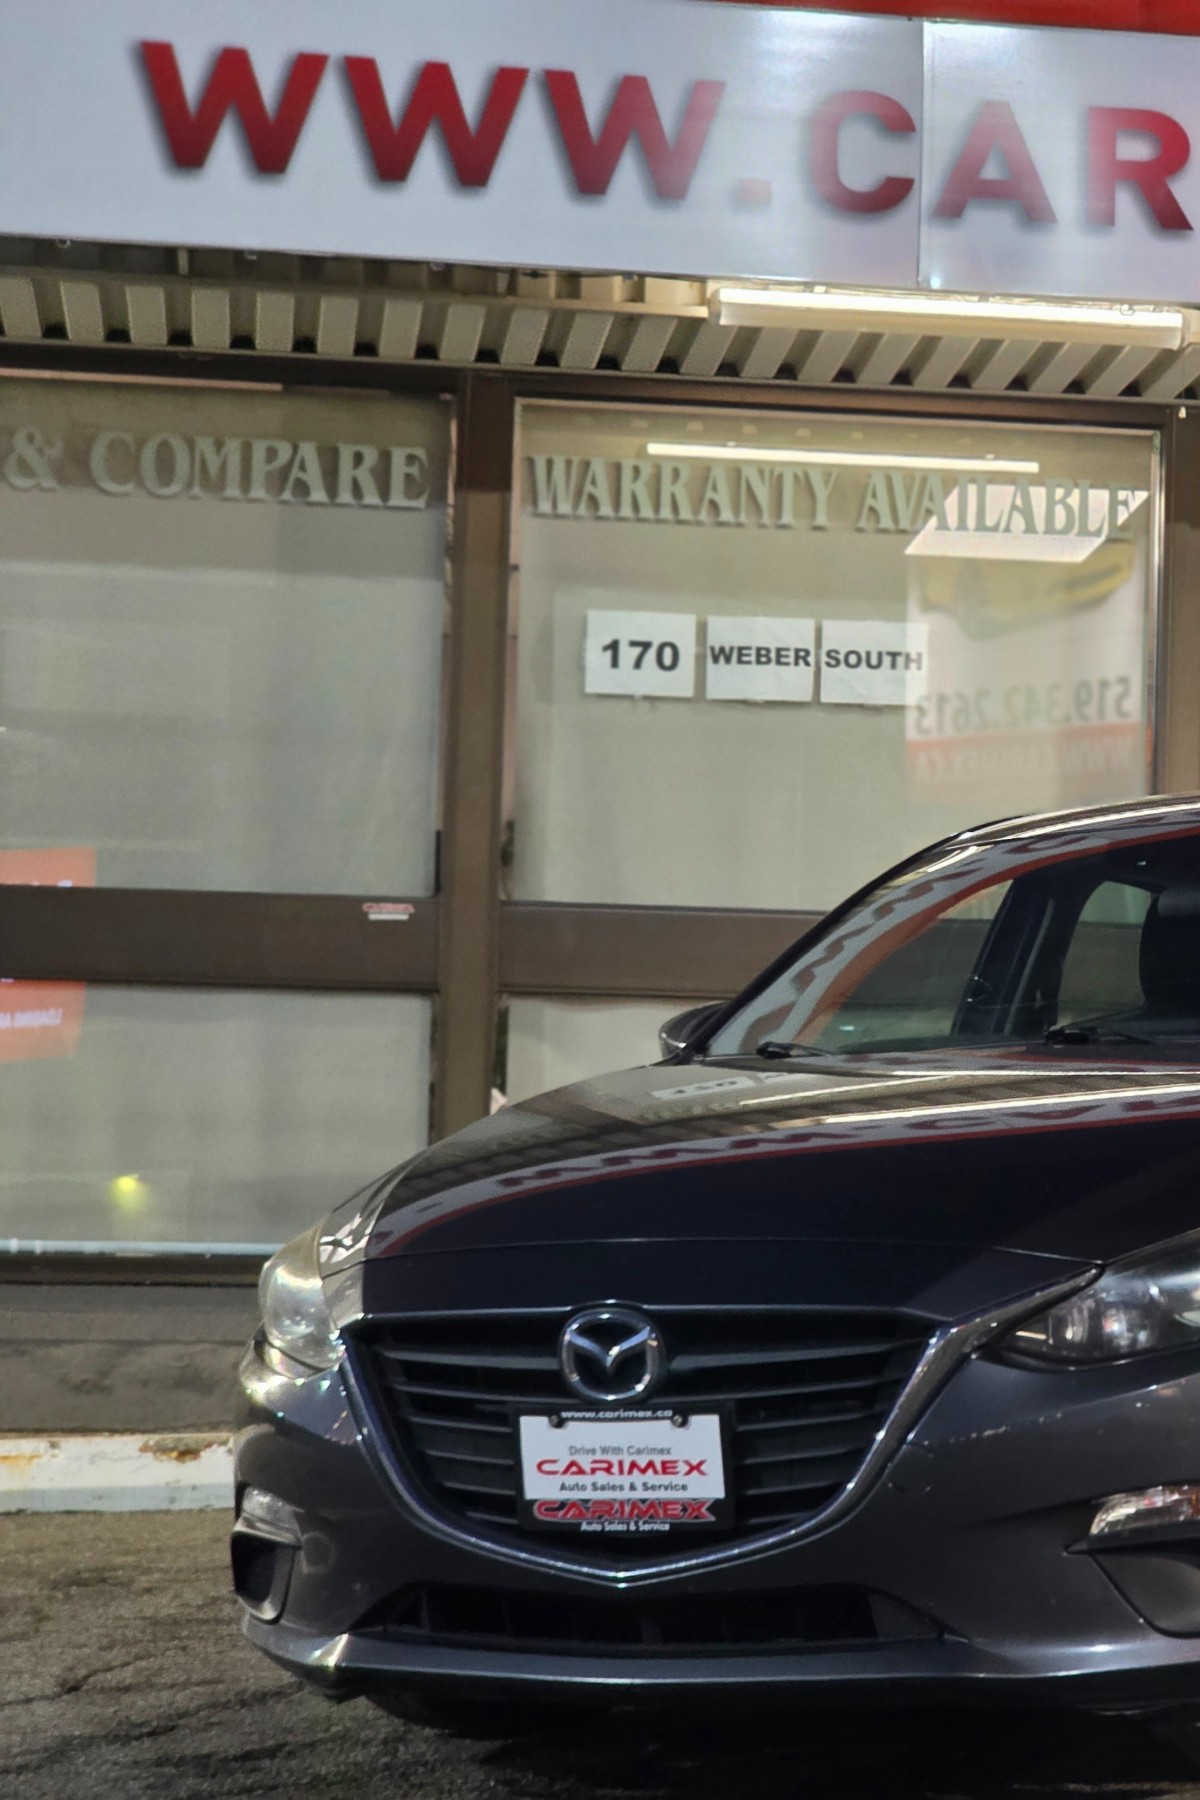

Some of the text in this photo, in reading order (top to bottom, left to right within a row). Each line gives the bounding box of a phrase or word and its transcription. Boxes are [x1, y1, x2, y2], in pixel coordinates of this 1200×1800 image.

[2, 426, 429, 510] & COMPARE
[530, 455, 1136, 540] WARRANTY AVAILABLE
[600, 639, 923, 672] 170 WEBER SOUTH
[560, 1408, 673, 1419] www.carimex.ca
[568, 1445, 672, 1456] Drive With Carimex
[536, 1459, 708, 1476] CARIMEX
[559, 1480, 689, 1493] Auto Sales & Service
[534, 1498, 714, 1521] CARIMEX
[580, 1520, 671, 1532] Auto Sales & Service
